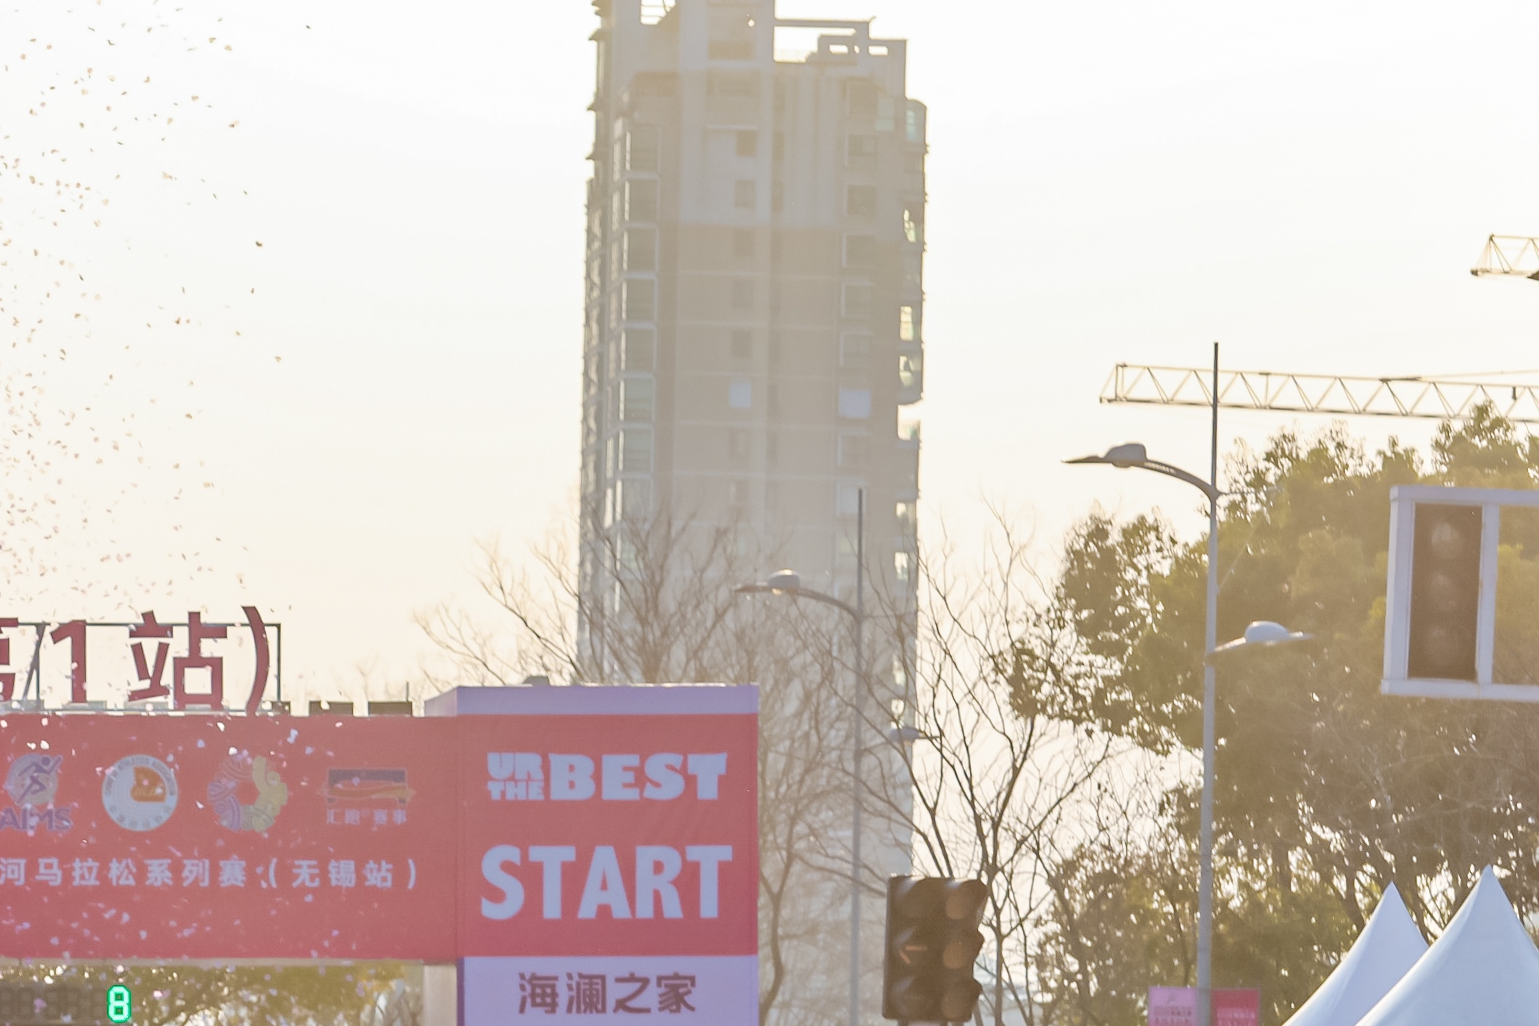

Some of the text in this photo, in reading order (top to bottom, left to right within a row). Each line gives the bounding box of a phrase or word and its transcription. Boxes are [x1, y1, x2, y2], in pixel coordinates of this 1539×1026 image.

[487, 752, 543, 780] UR
[549, 752, 727, 800] BEST
[487, 780, 544, 800] THE
[481, 845, 733, 920] START
[107, 984, 132, 1024] 8
[518, 972, 697, 1014] 海澜之家
